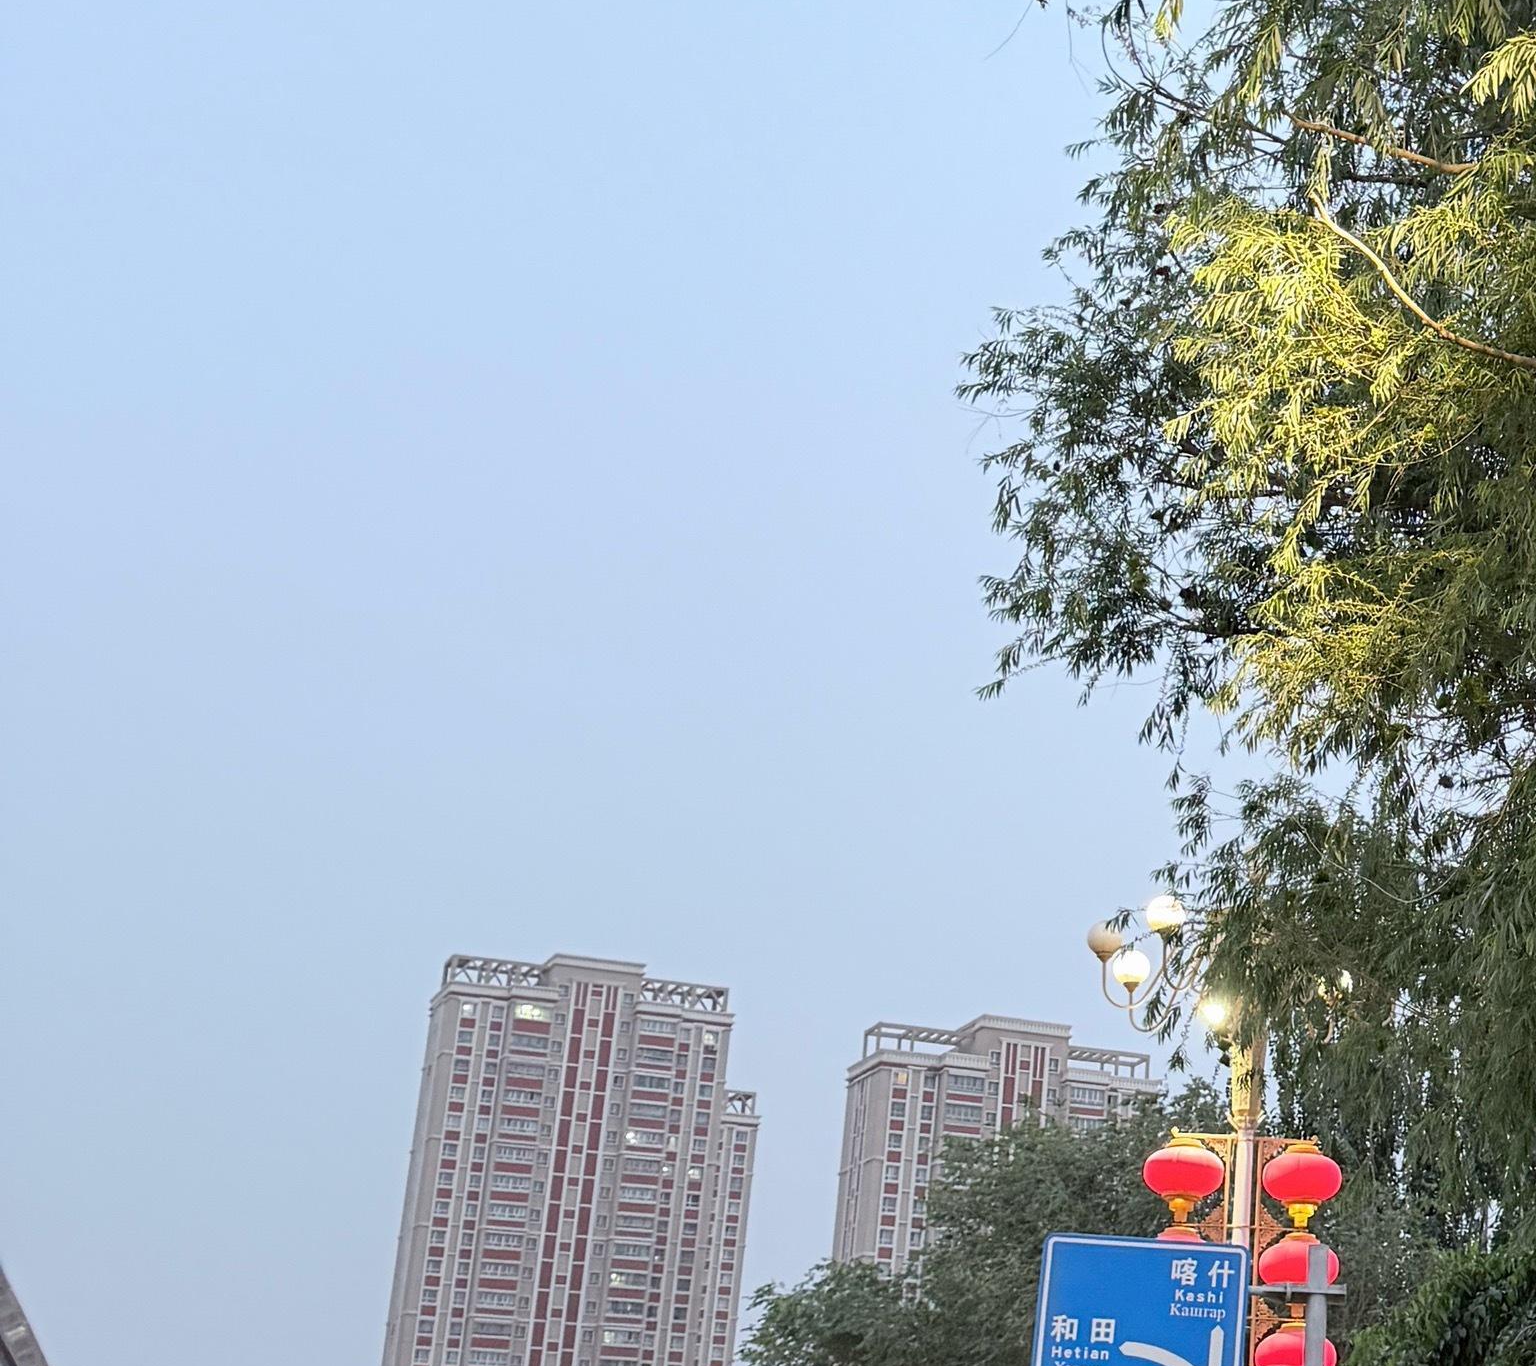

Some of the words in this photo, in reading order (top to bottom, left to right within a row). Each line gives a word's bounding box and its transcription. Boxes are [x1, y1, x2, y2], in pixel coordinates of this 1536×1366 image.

[1170, 1257, 1236, 1288] 喀什
[1174, 1289, 1224, 1304] Kashi
[1169, 1303, 1227, 1322] Кашгар
[1050, 1315, 1116, 1344] 和田
[1051, 1345, 1109, 1360] Hetian
